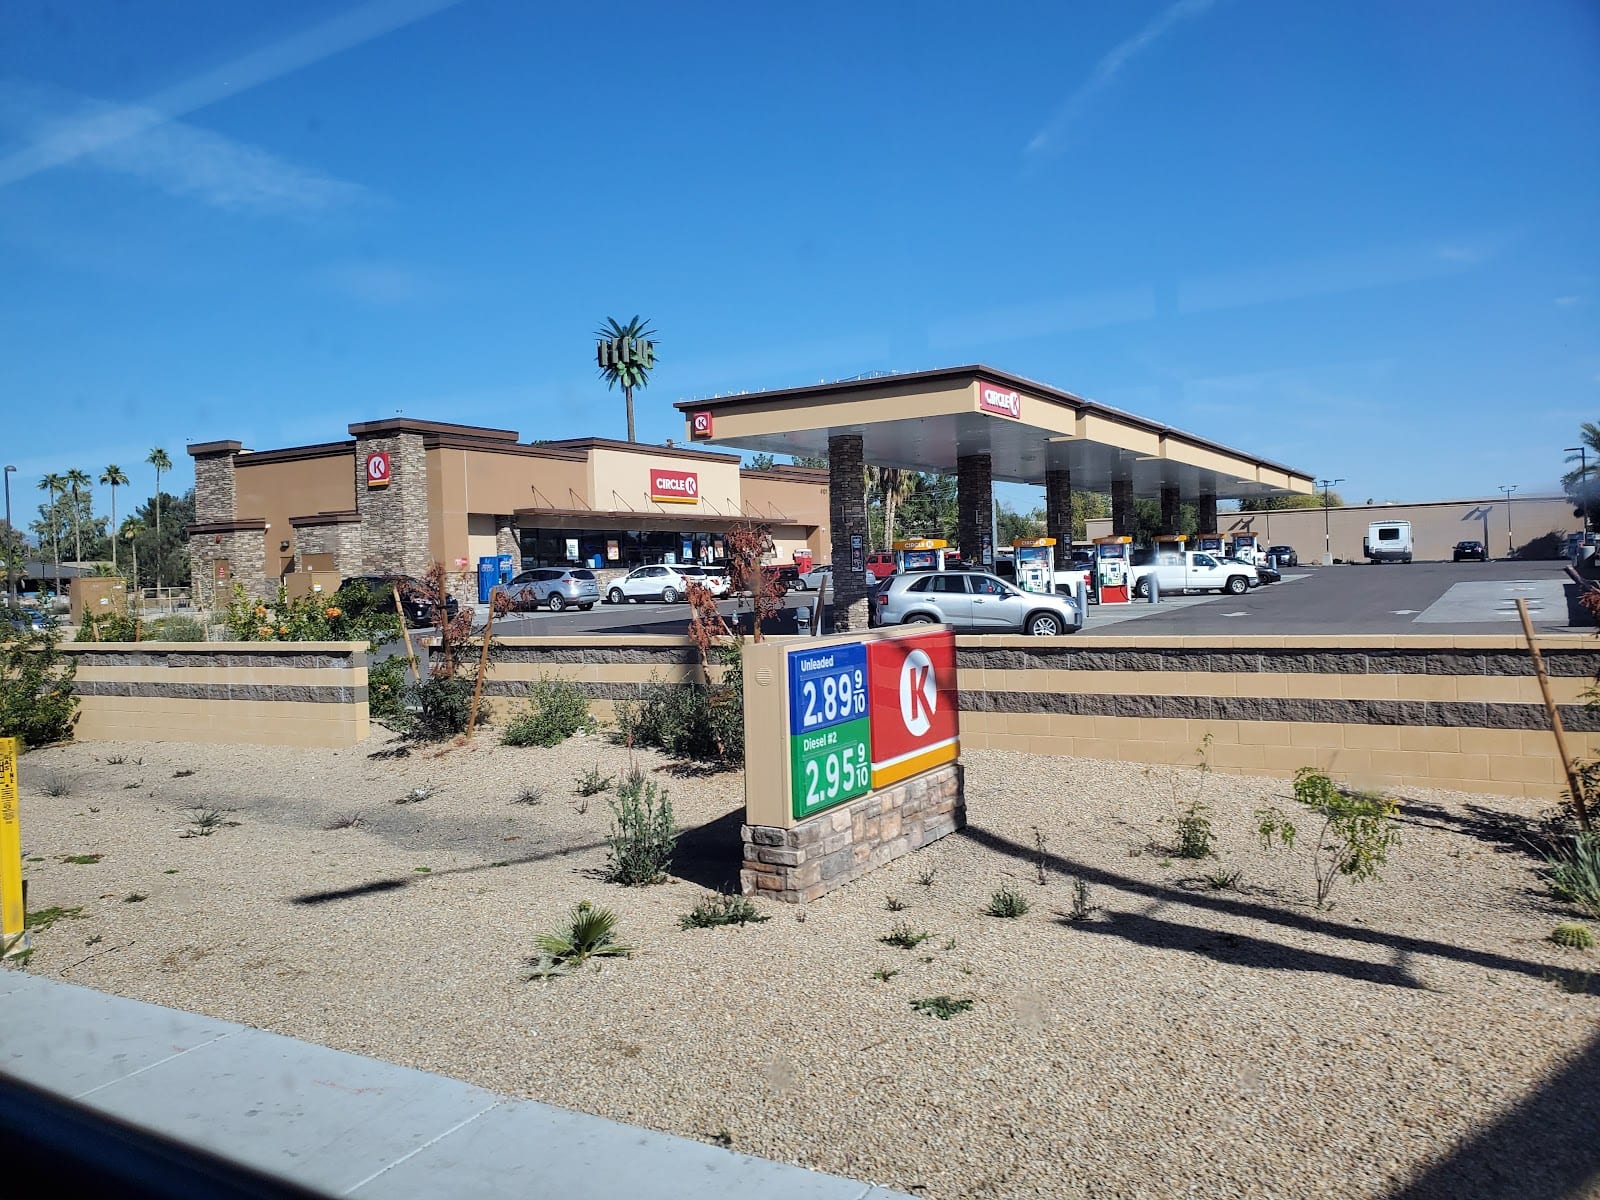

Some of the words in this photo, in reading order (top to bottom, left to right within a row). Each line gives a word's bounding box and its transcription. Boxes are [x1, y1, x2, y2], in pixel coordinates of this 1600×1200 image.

[984, 390, 1010, 409] CIRCLE
[1010, 392, 1019, 415] K
[656, 478, 685, 490] CIRCLE
[686, 477, 696, 494] K
[801, 655, 834, 672] Unleaded
[804, 674, 851, 727] 2.89
[904, 657, 936, 731] K
[804, 734, 826, 751] Diesel
[828, 732, 837, 744] #2
[806, 748, 854, 806] 2.95
